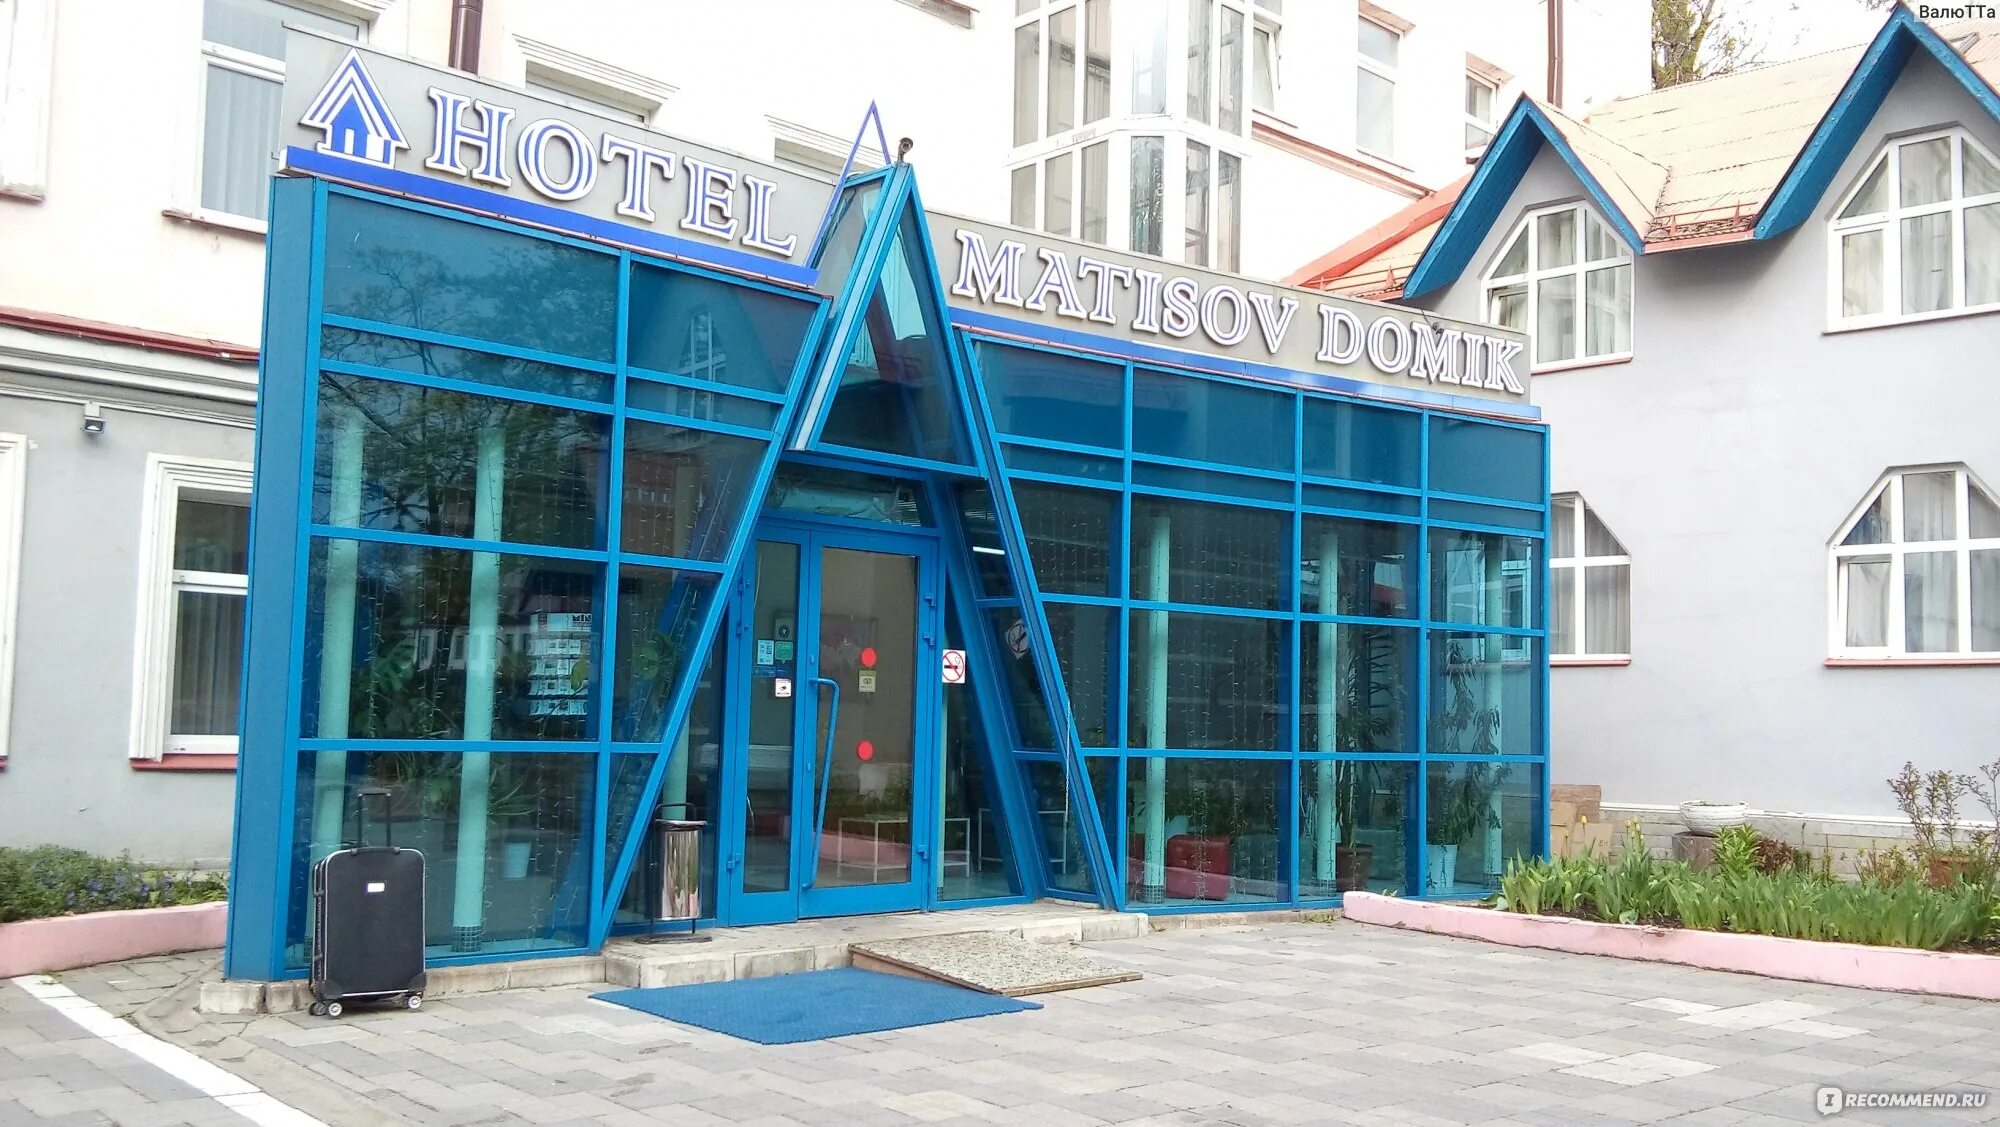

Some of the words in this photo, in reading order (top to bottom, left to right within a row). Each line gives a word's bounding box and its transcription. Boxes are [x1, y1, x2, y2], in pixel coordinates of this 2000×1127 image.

[424, 86, 798, 258] HOTEL
[951, 228, 1300, 354] MATISOV
[1316, 303, 1526, 394] DOMIK
